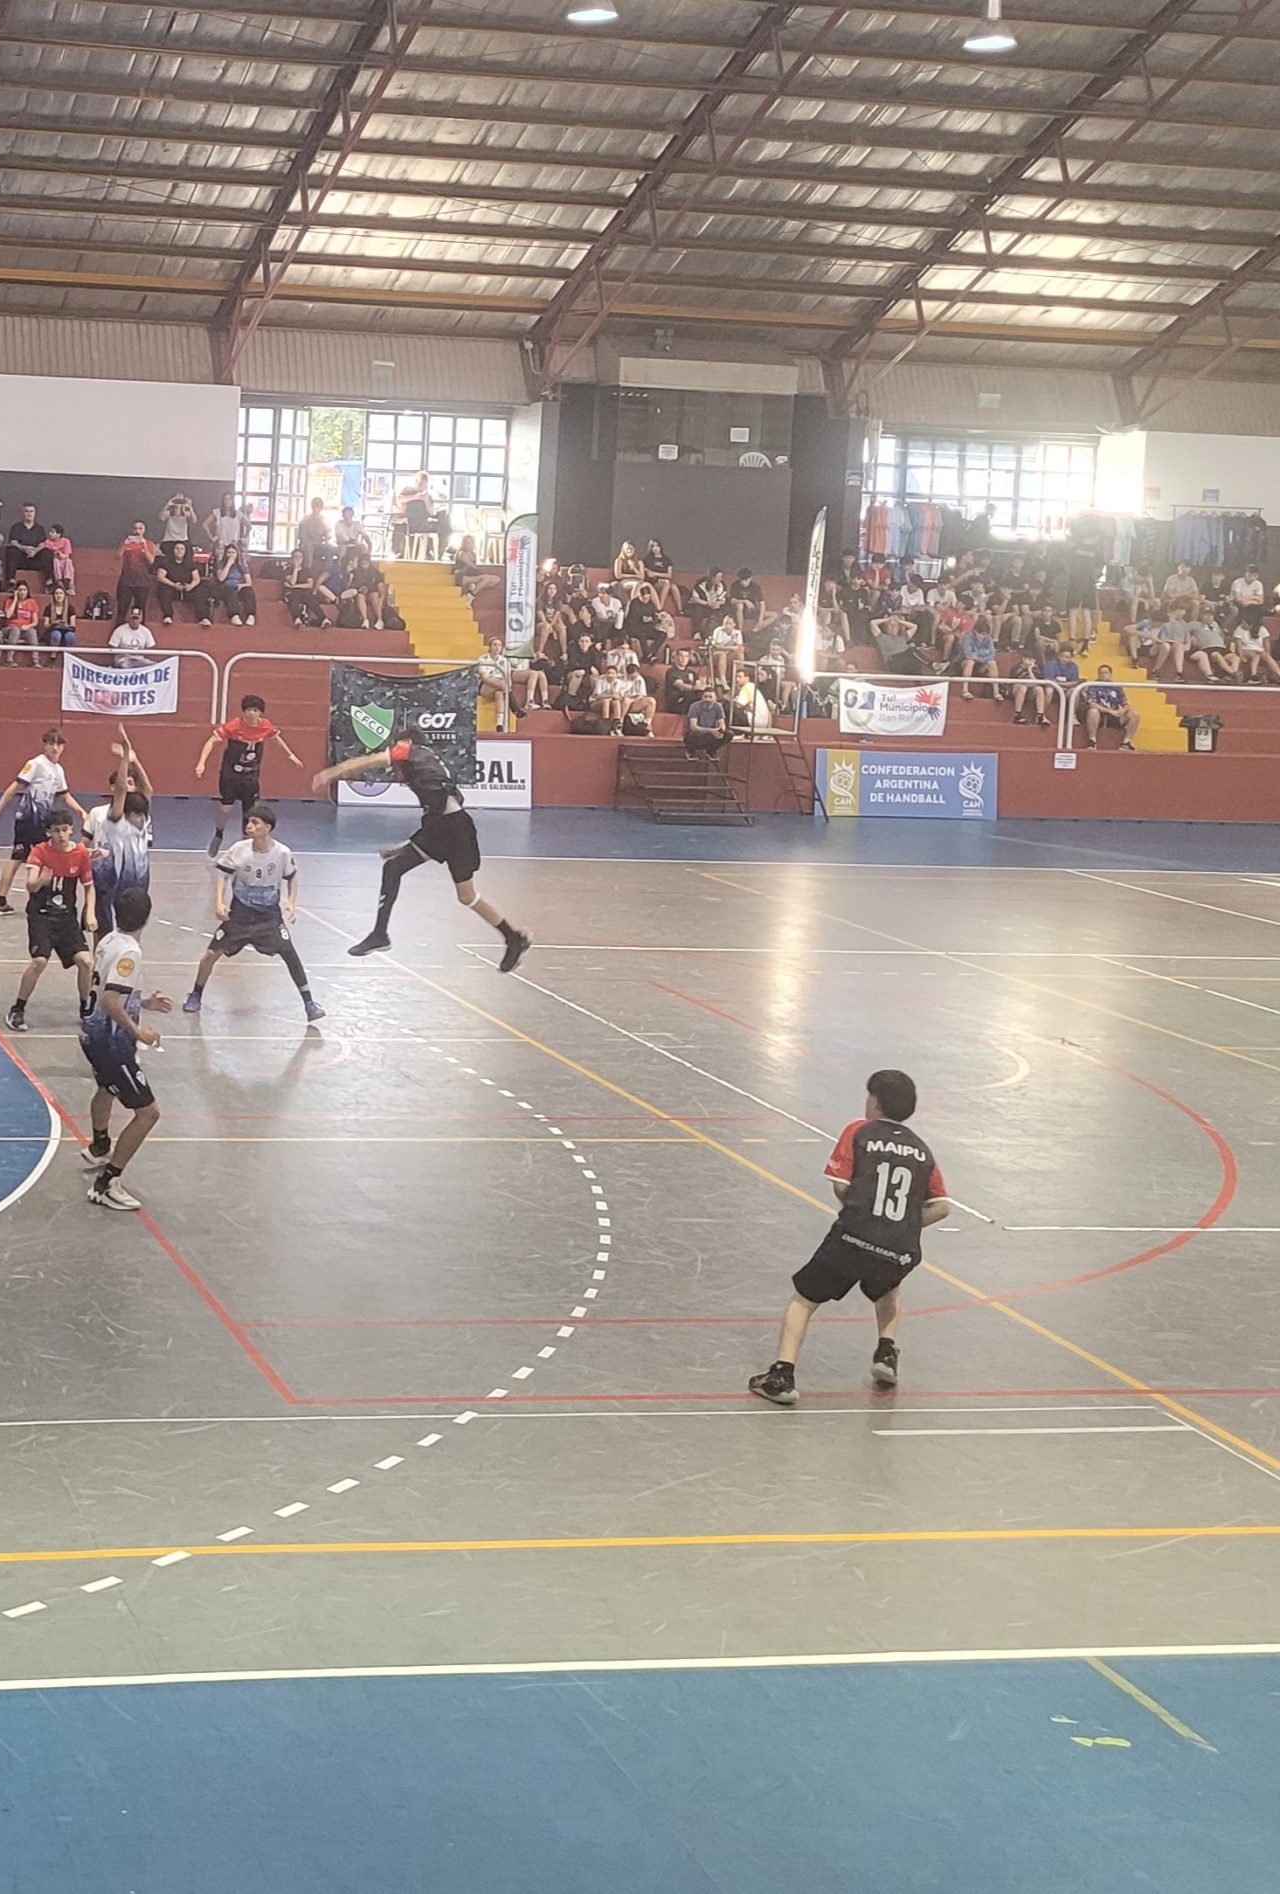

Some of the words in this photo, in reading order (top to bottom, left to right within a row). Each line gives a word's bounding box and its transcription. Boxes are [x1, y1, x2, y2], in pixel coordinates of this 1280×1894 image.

[72, 664, 149, 686] DIRECCIÓN
[153, 667, 171, 683] DE
[879, 702, 929, 714] Municipio
[418, 712, 457, 728] GO7
[473, 760, 526, 784] BAL.
[861, 765, 955, 777] CONFEDERACION
[875, 779, 939, 790] ARGENTINA
[870, 793, 884, 802] DE
[886, 793, 946, 804] HANDBALL
[866, 1140, 926, 1162] MAIPU
[872, 1161, 912, 1222] 13
